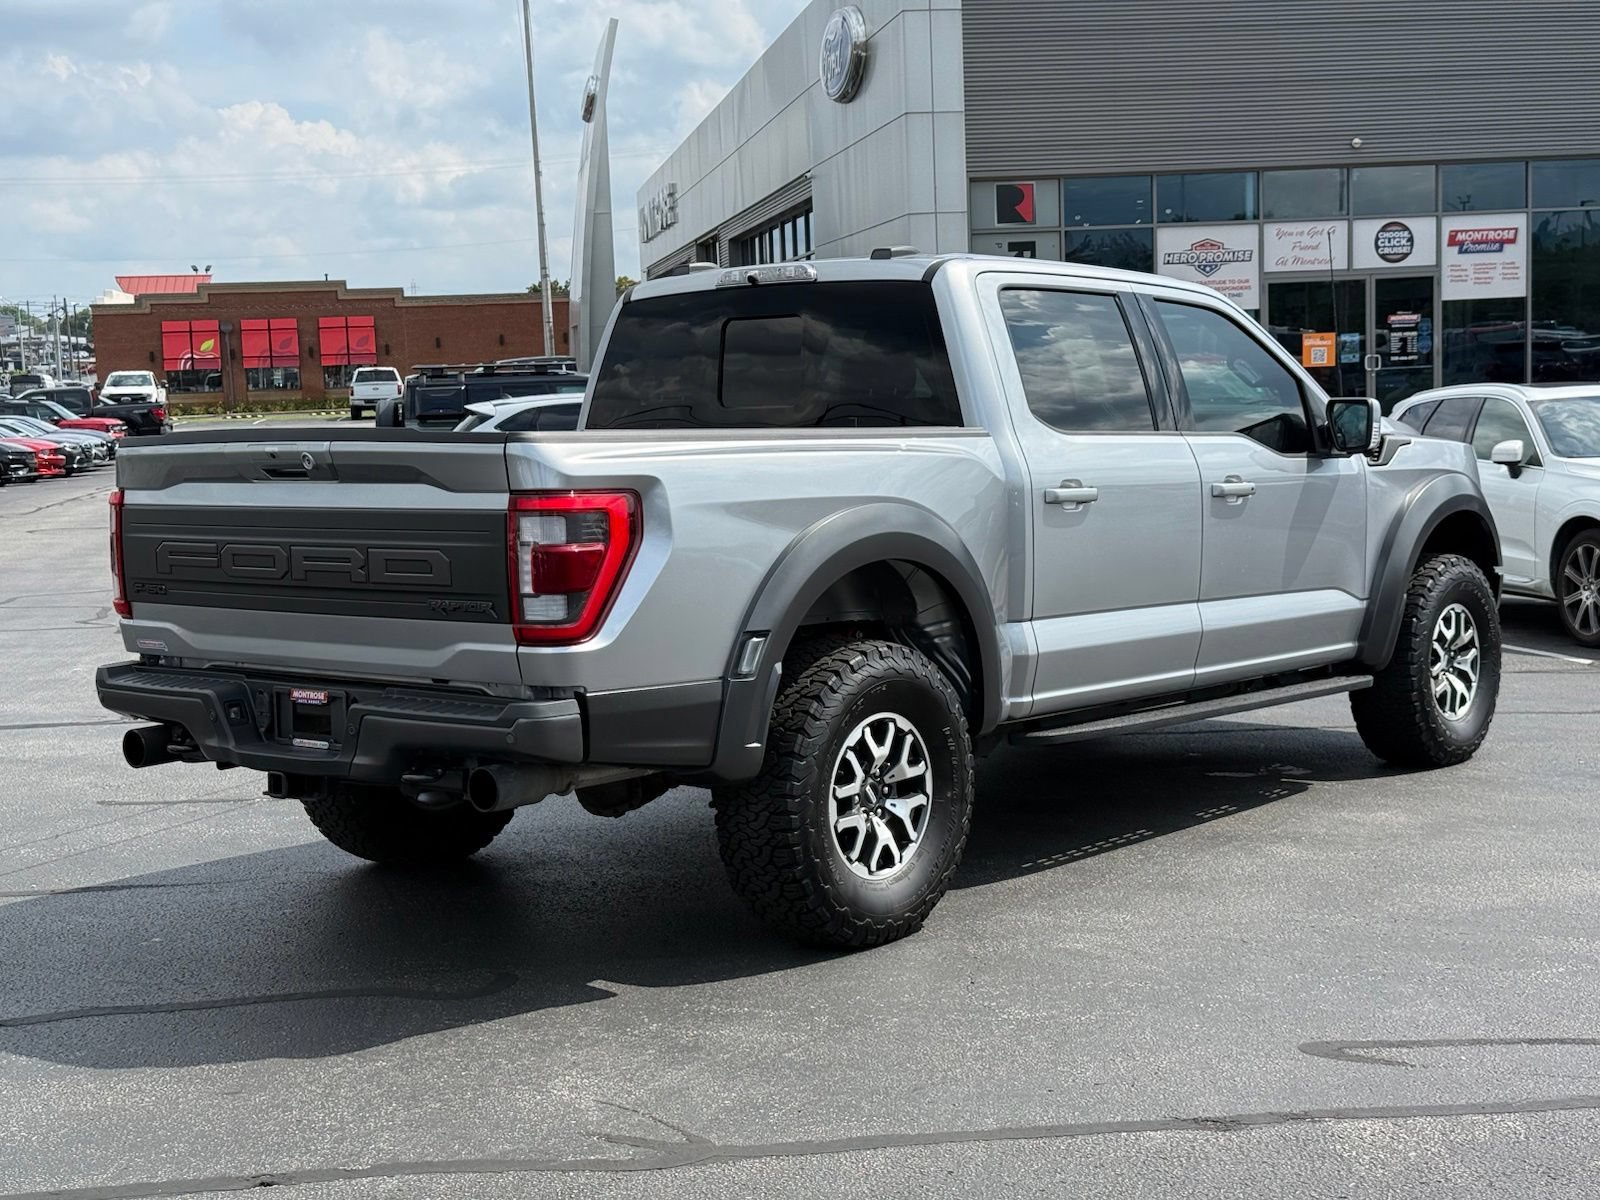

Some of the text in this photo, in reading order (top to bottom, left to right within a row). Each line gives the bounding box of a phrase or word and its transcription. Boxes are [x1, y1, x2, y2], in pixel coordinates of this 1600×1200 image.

[1455, 229, 1517, 241] MONTROSE
[1291, 241, 1321, 252] Friend
[1462, 241, 1501, 252] Promise
[1163, 249, 1253, 265] HERO PROMISE
[155, 541, 453, 587] FORD
[428, 600, 498, 619] RAPTOR
[292, 690, 325, 700] MONTROSE
